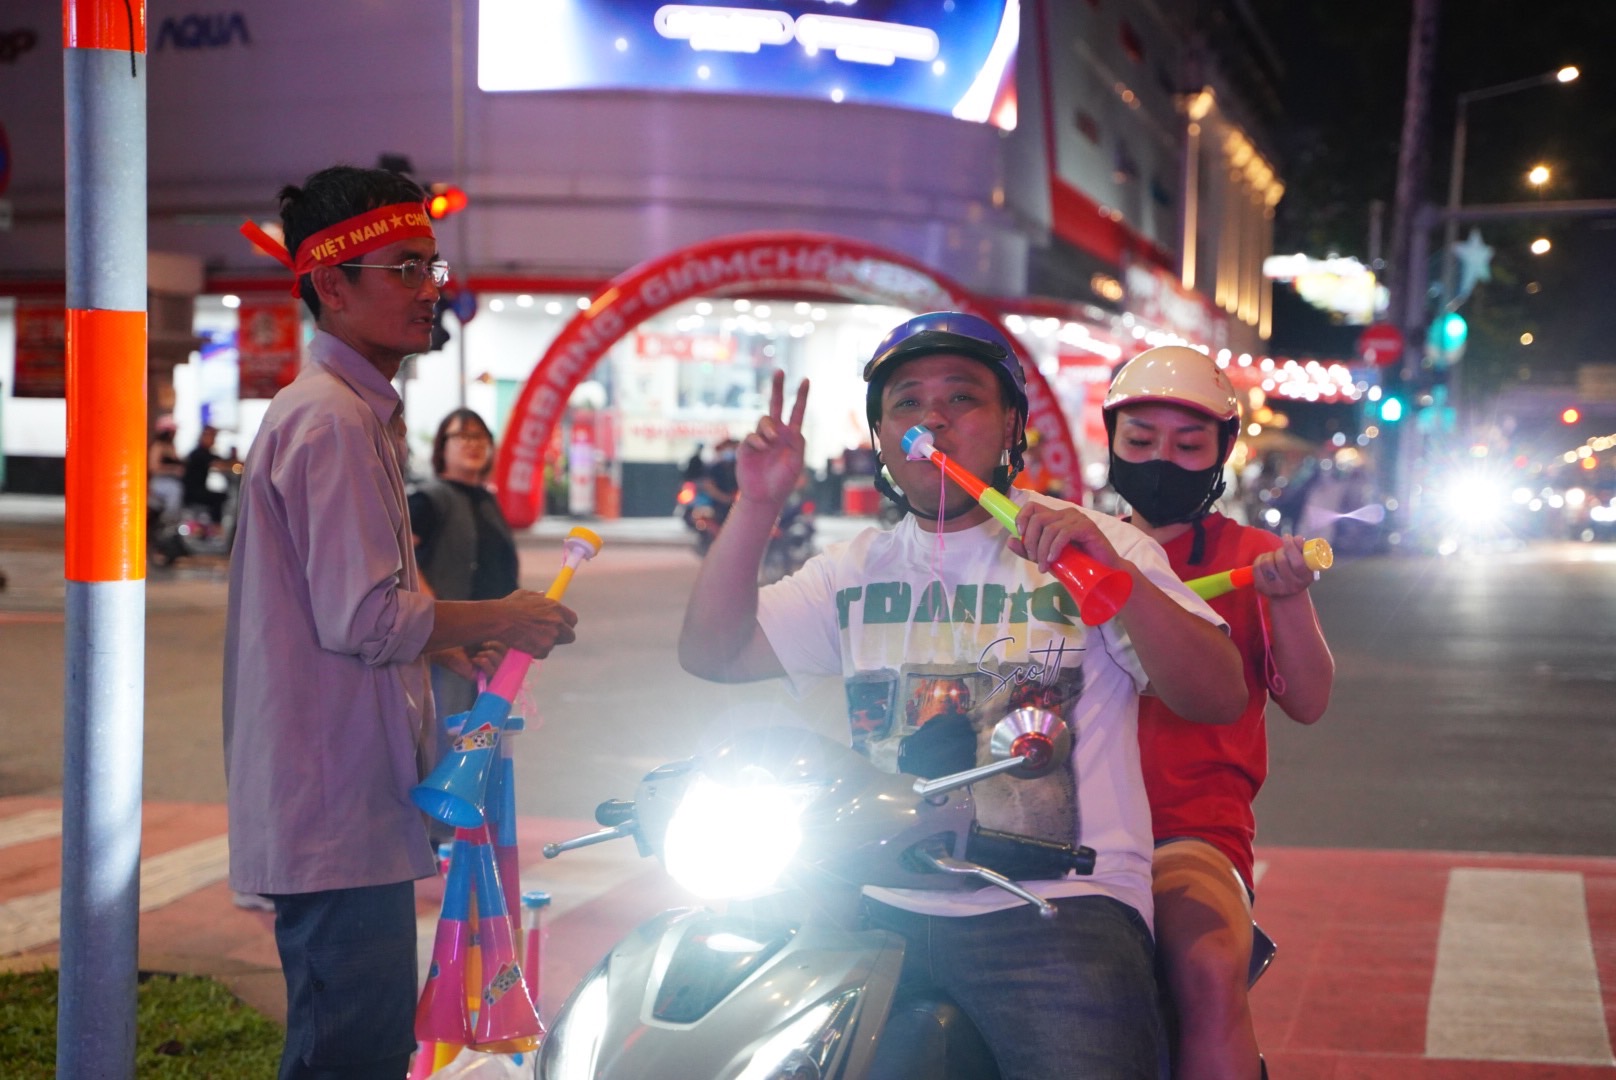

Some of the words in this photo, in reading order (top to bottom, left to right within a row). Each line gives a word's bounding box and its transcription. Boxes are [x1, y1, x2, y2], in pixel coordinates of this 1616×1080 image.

[154, 13, 252, 52] AQUA
[311, 236, 346, 261] VIỆT
[349, 219, 389, 245] NAM
[977, 636, 1087, 703] Scott
